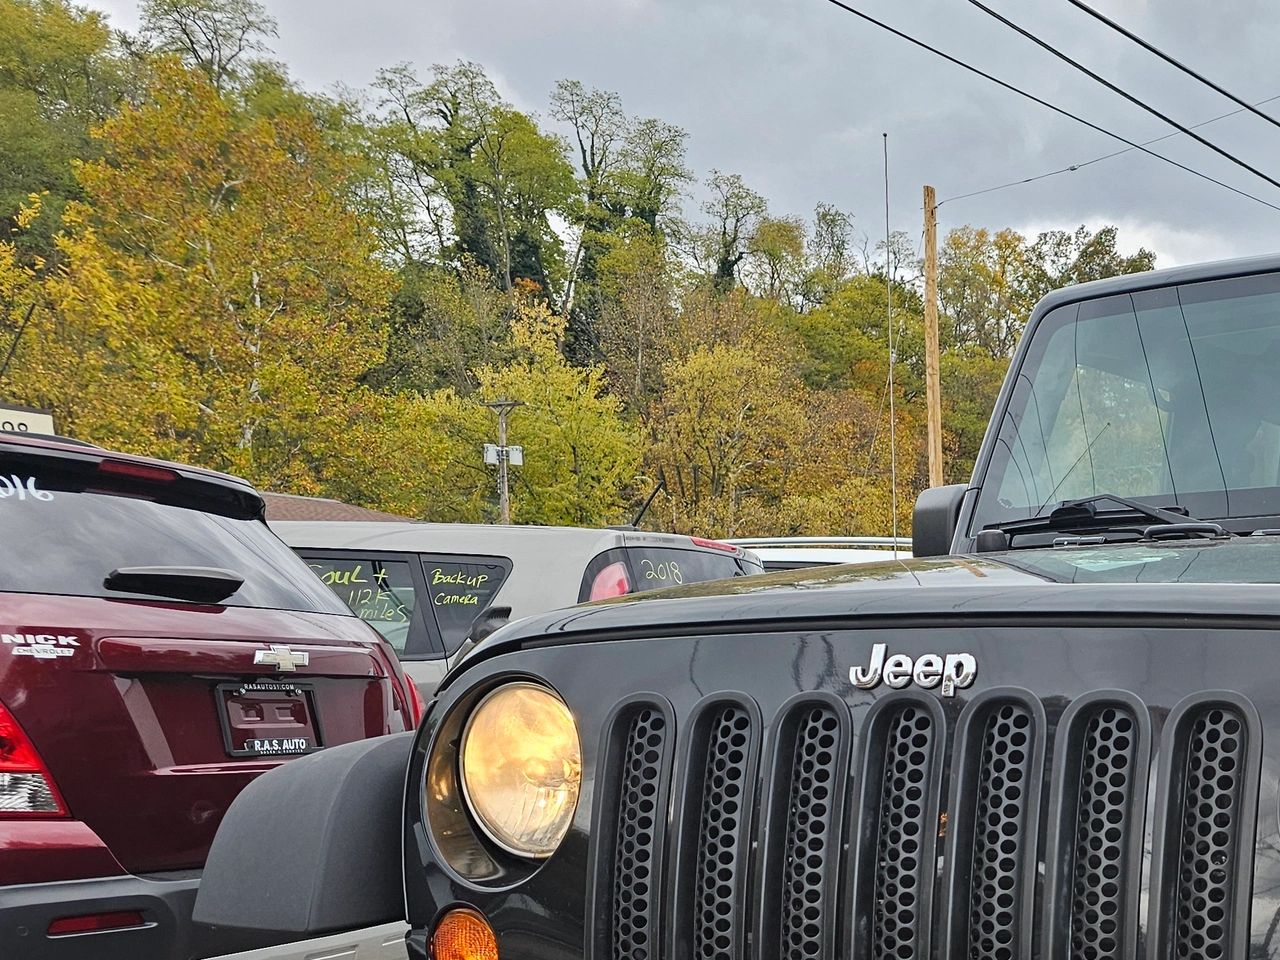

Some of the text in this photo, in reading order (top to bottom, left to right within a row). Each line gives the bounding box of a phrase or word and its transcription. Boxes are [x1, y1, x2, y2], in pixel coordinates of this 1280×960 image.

[641, 559, 683, 584] 2018
[1, 633, 81, 646] NICK
[849, 643, 976, 697] Jeep
[254, 738, 306, 751] R.A.S. AUTO
